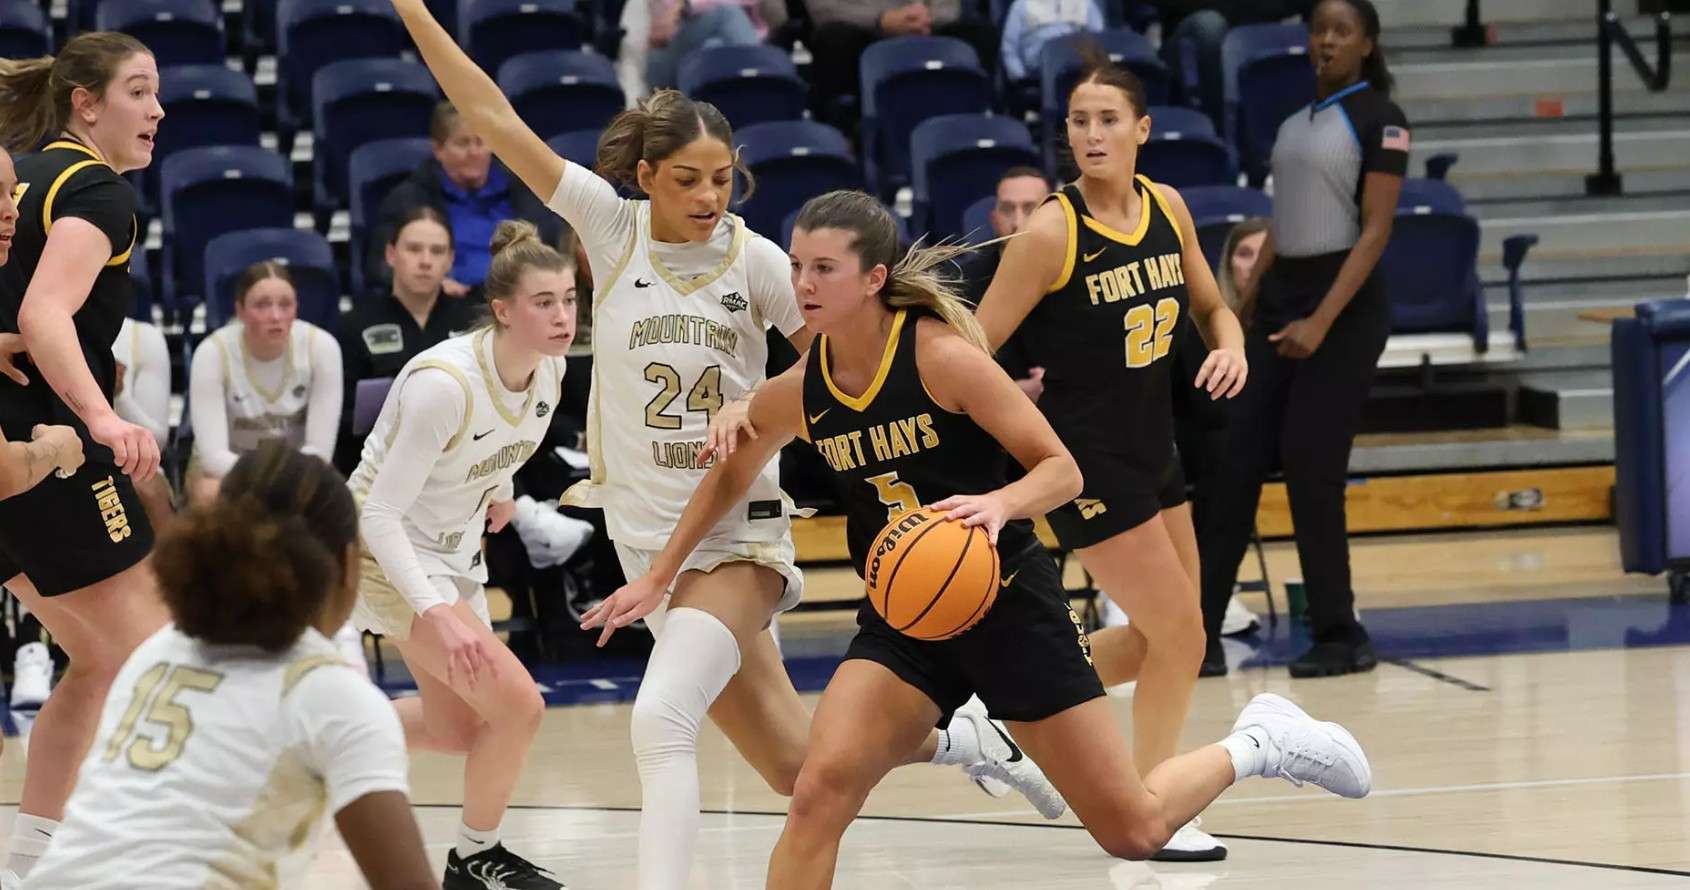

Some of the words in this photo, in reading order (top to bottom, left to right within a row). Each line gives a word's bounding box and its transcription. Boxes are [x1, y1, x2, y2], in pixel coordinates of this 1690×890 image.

[1085, 261, 1145, 305] FORT
[1123, 297, 1180, 368] 22
[643, 361, 724, 430] 24
[868, 413, 940, 462] HAYS
[91, 475, 132, 543] TIGERS
[864, 471, 921, 522] 5
[869, 512, 929, 590] Wilson
[102, 661, 226, 773] 15
